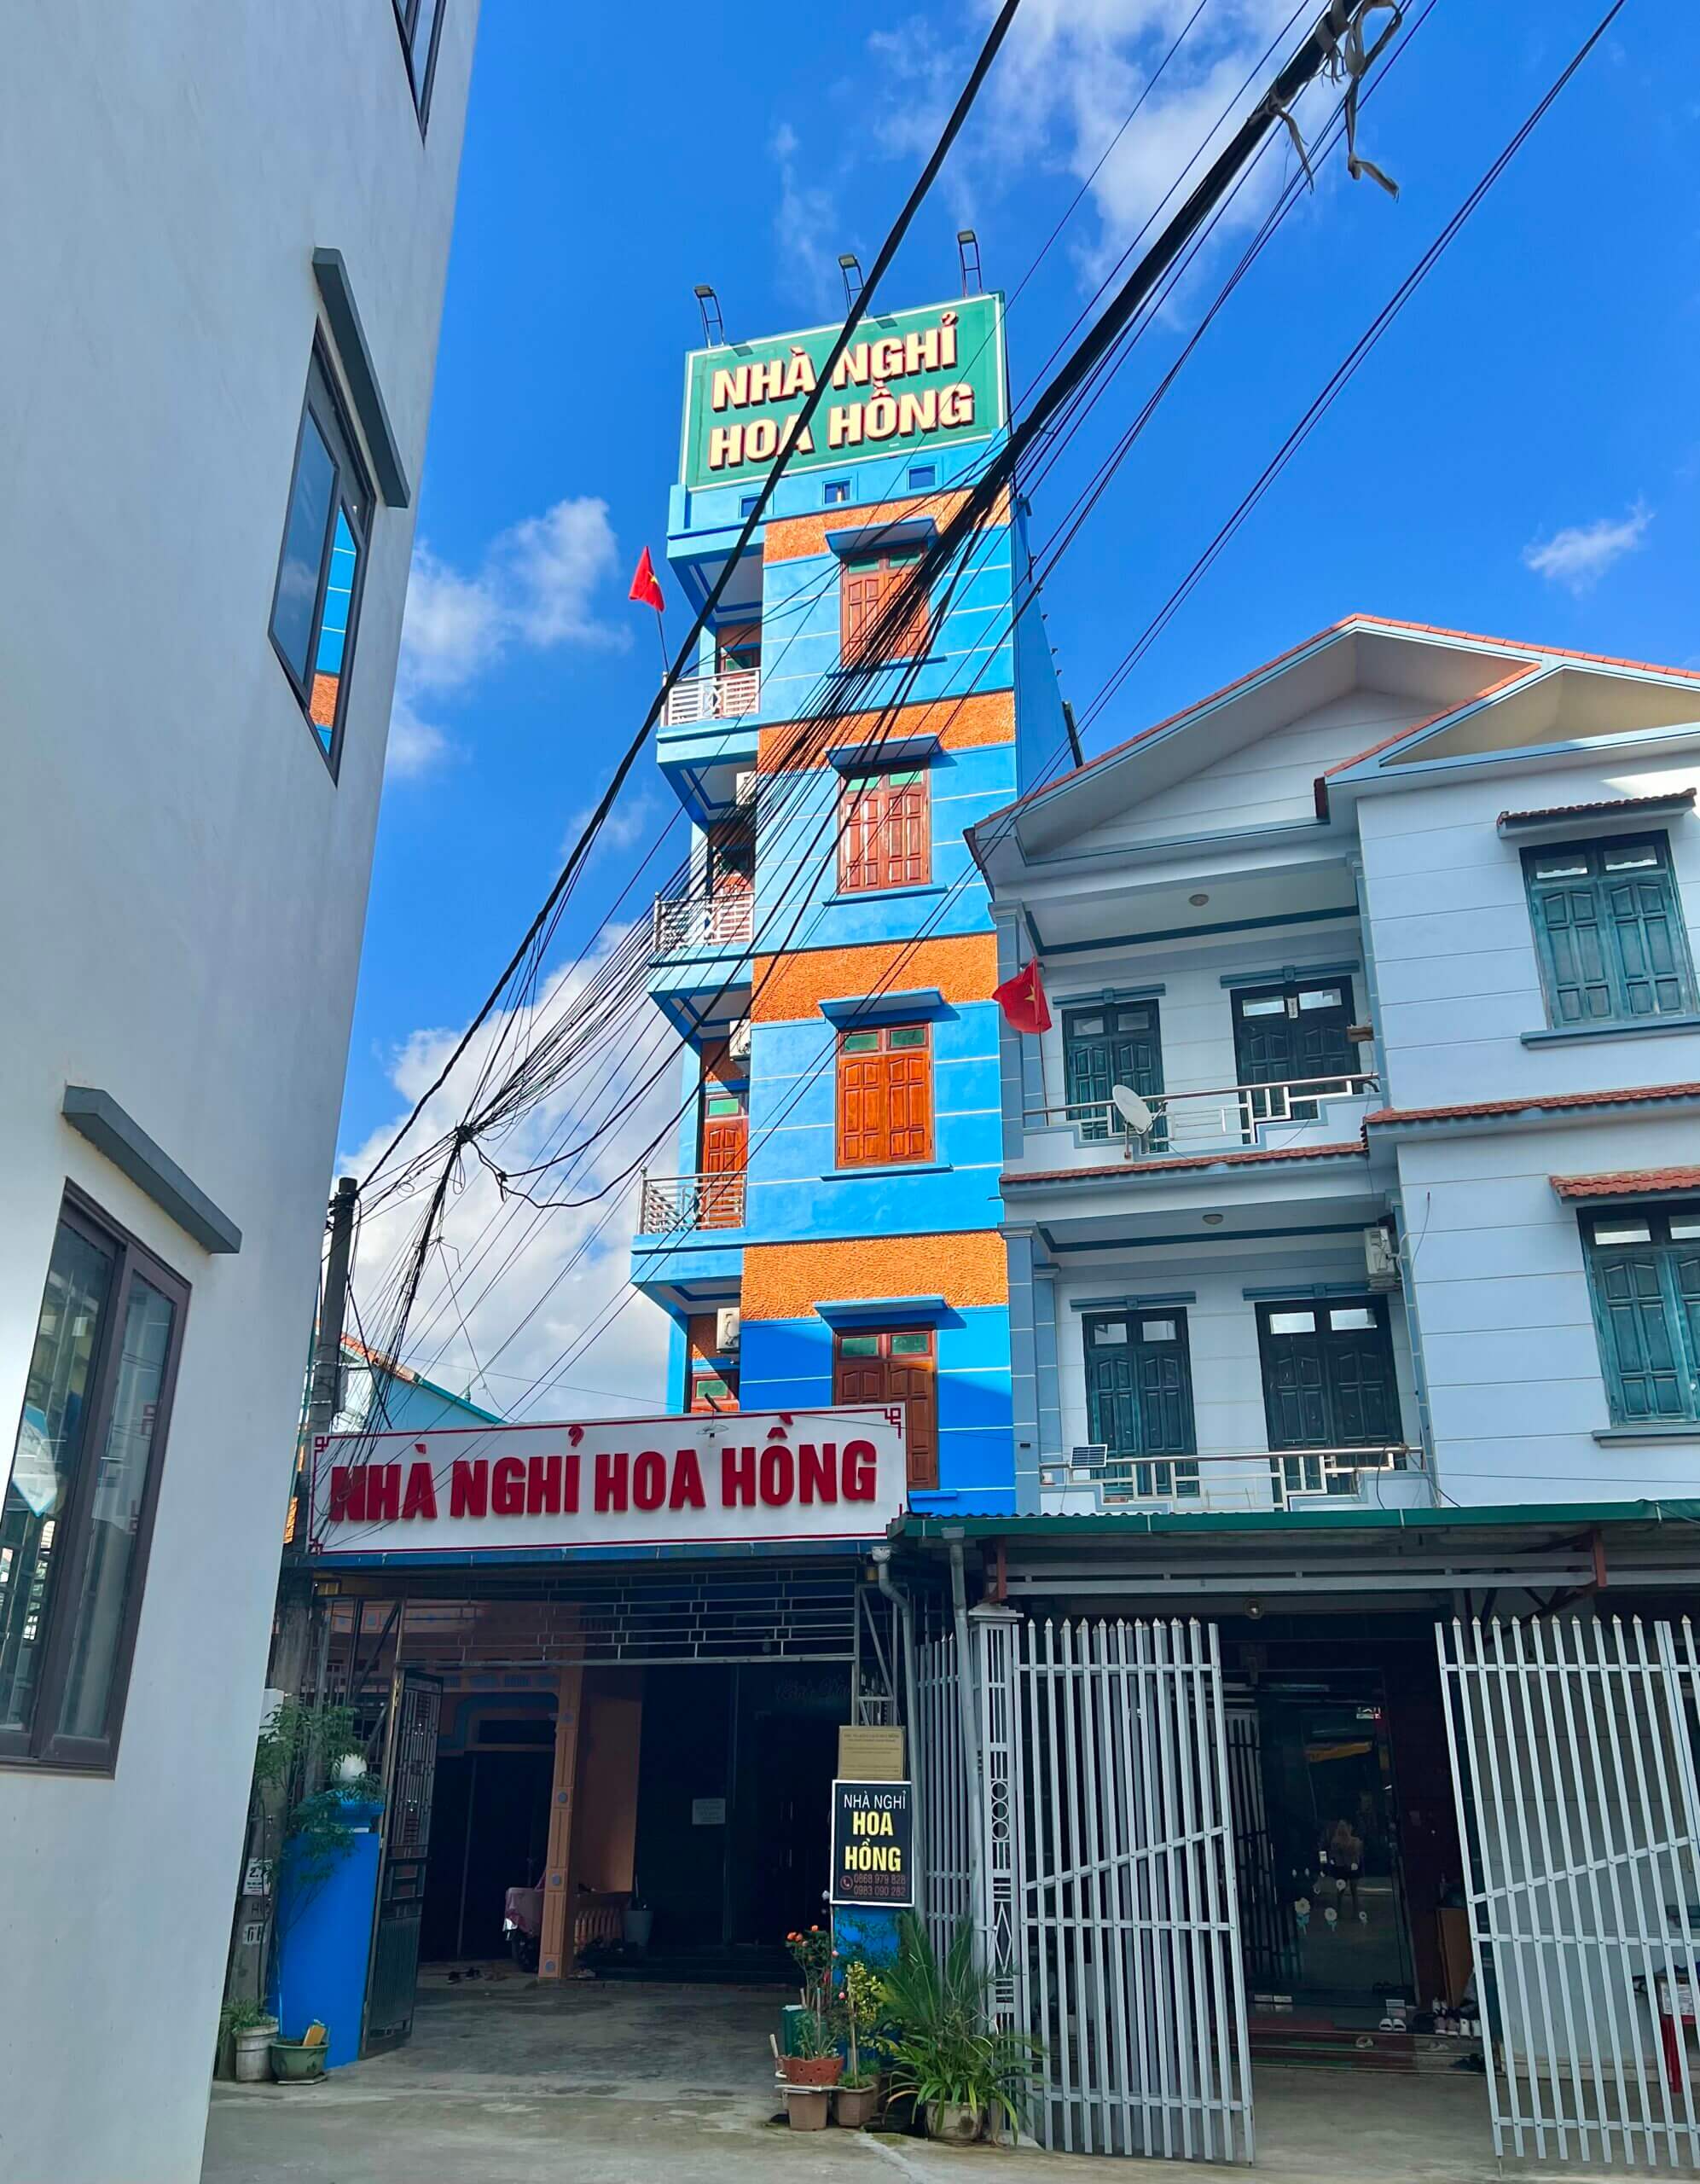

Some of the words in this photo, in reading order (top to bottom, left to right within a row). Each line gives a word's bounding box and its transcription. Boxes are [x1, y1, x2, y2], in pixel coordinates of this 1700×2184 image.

[711, 346, 817, 411] NHÀ
[832, 311, 959, 390] NGHỈ
[709, 415, 815, 469] HOA
[827, 380, 974, 449] HỒNG
[329, 1443, 438, 1522] NHÀ
[450, 1425, 585, 1519] NGHỈ
[595, 1449, 707, 1513] HOA
[722, 1414, 879, 1507] HỒNG
[844, 1791, 870, 1809] NHÀ
[874, 1790, 907, 1809] NGHỈ
[852, 1811, 894, 1836] HOA
[844, 1838, 902, 1872] HỒNG
